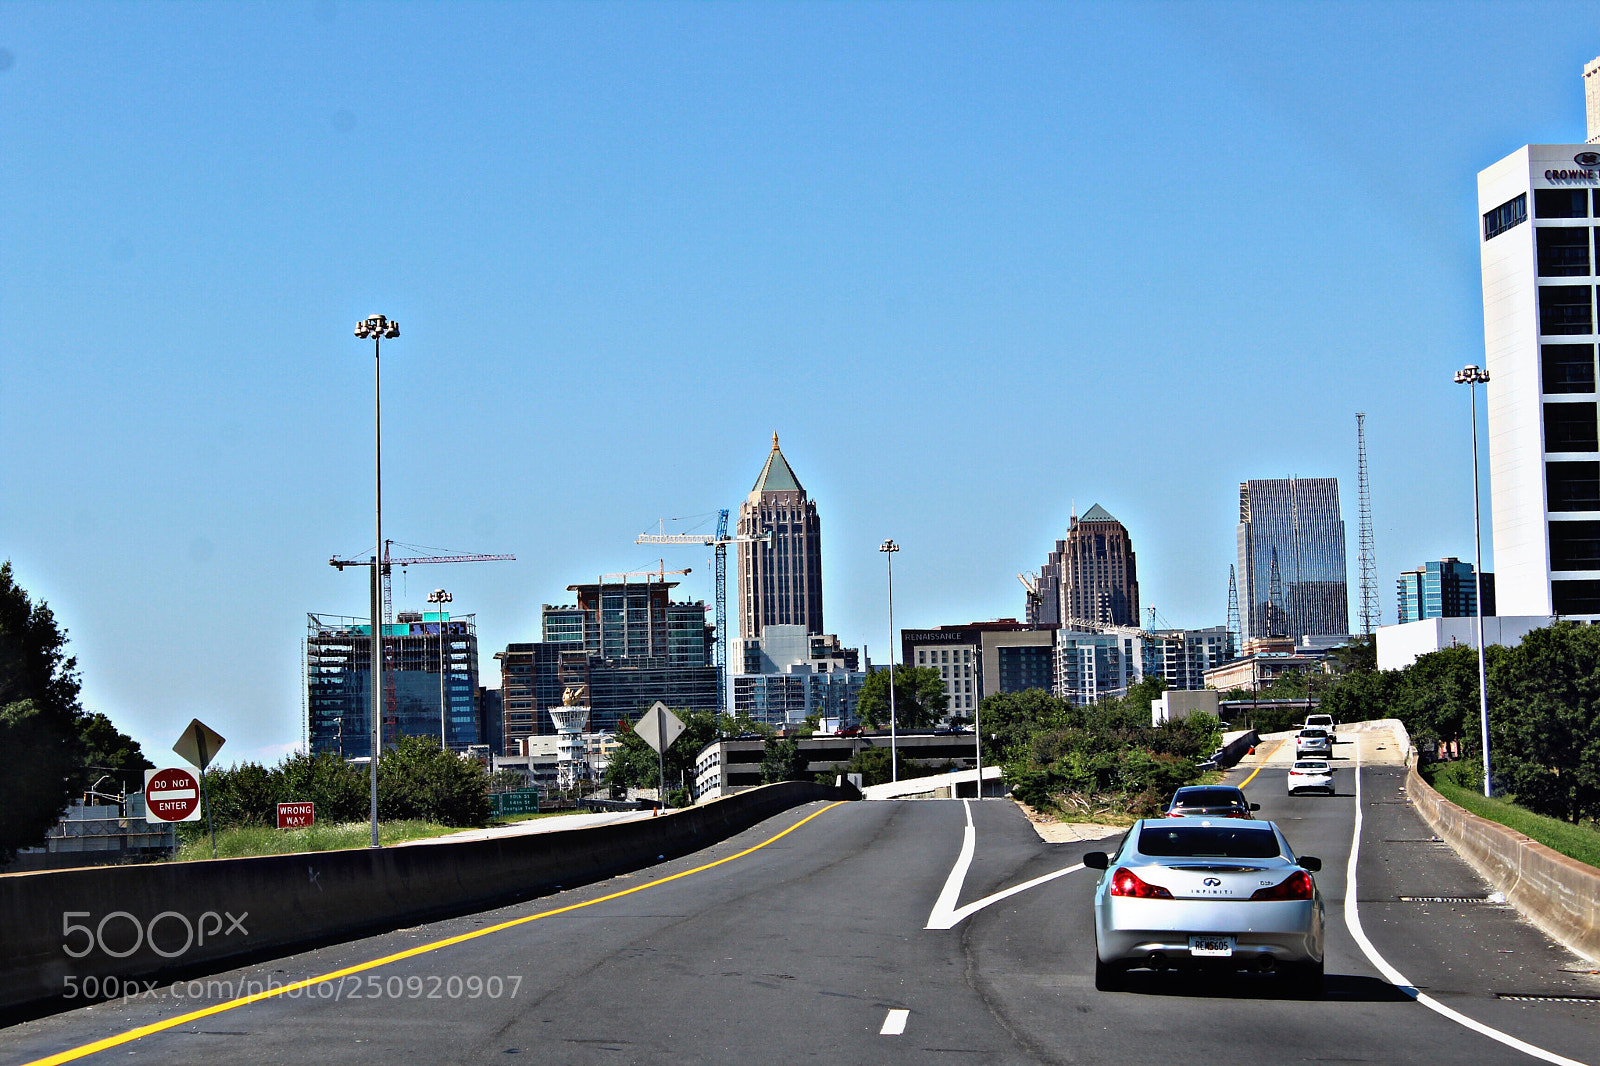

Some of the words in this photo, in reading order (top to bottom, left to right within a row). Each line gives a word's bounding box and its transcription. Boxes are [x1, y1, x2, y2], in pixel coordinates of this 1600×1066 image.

[1544, 169, 1594, 180] CROWNE
[904, 632, 962, 641] RENAISSANCE
[154, 780, 167, 789] DO
[172, 779, 190, 788] NOT
[159, 801, 188, 811] ENTER
[280, 806, 312, 815] WRONG
[286, 816, 306, 825] WAY
